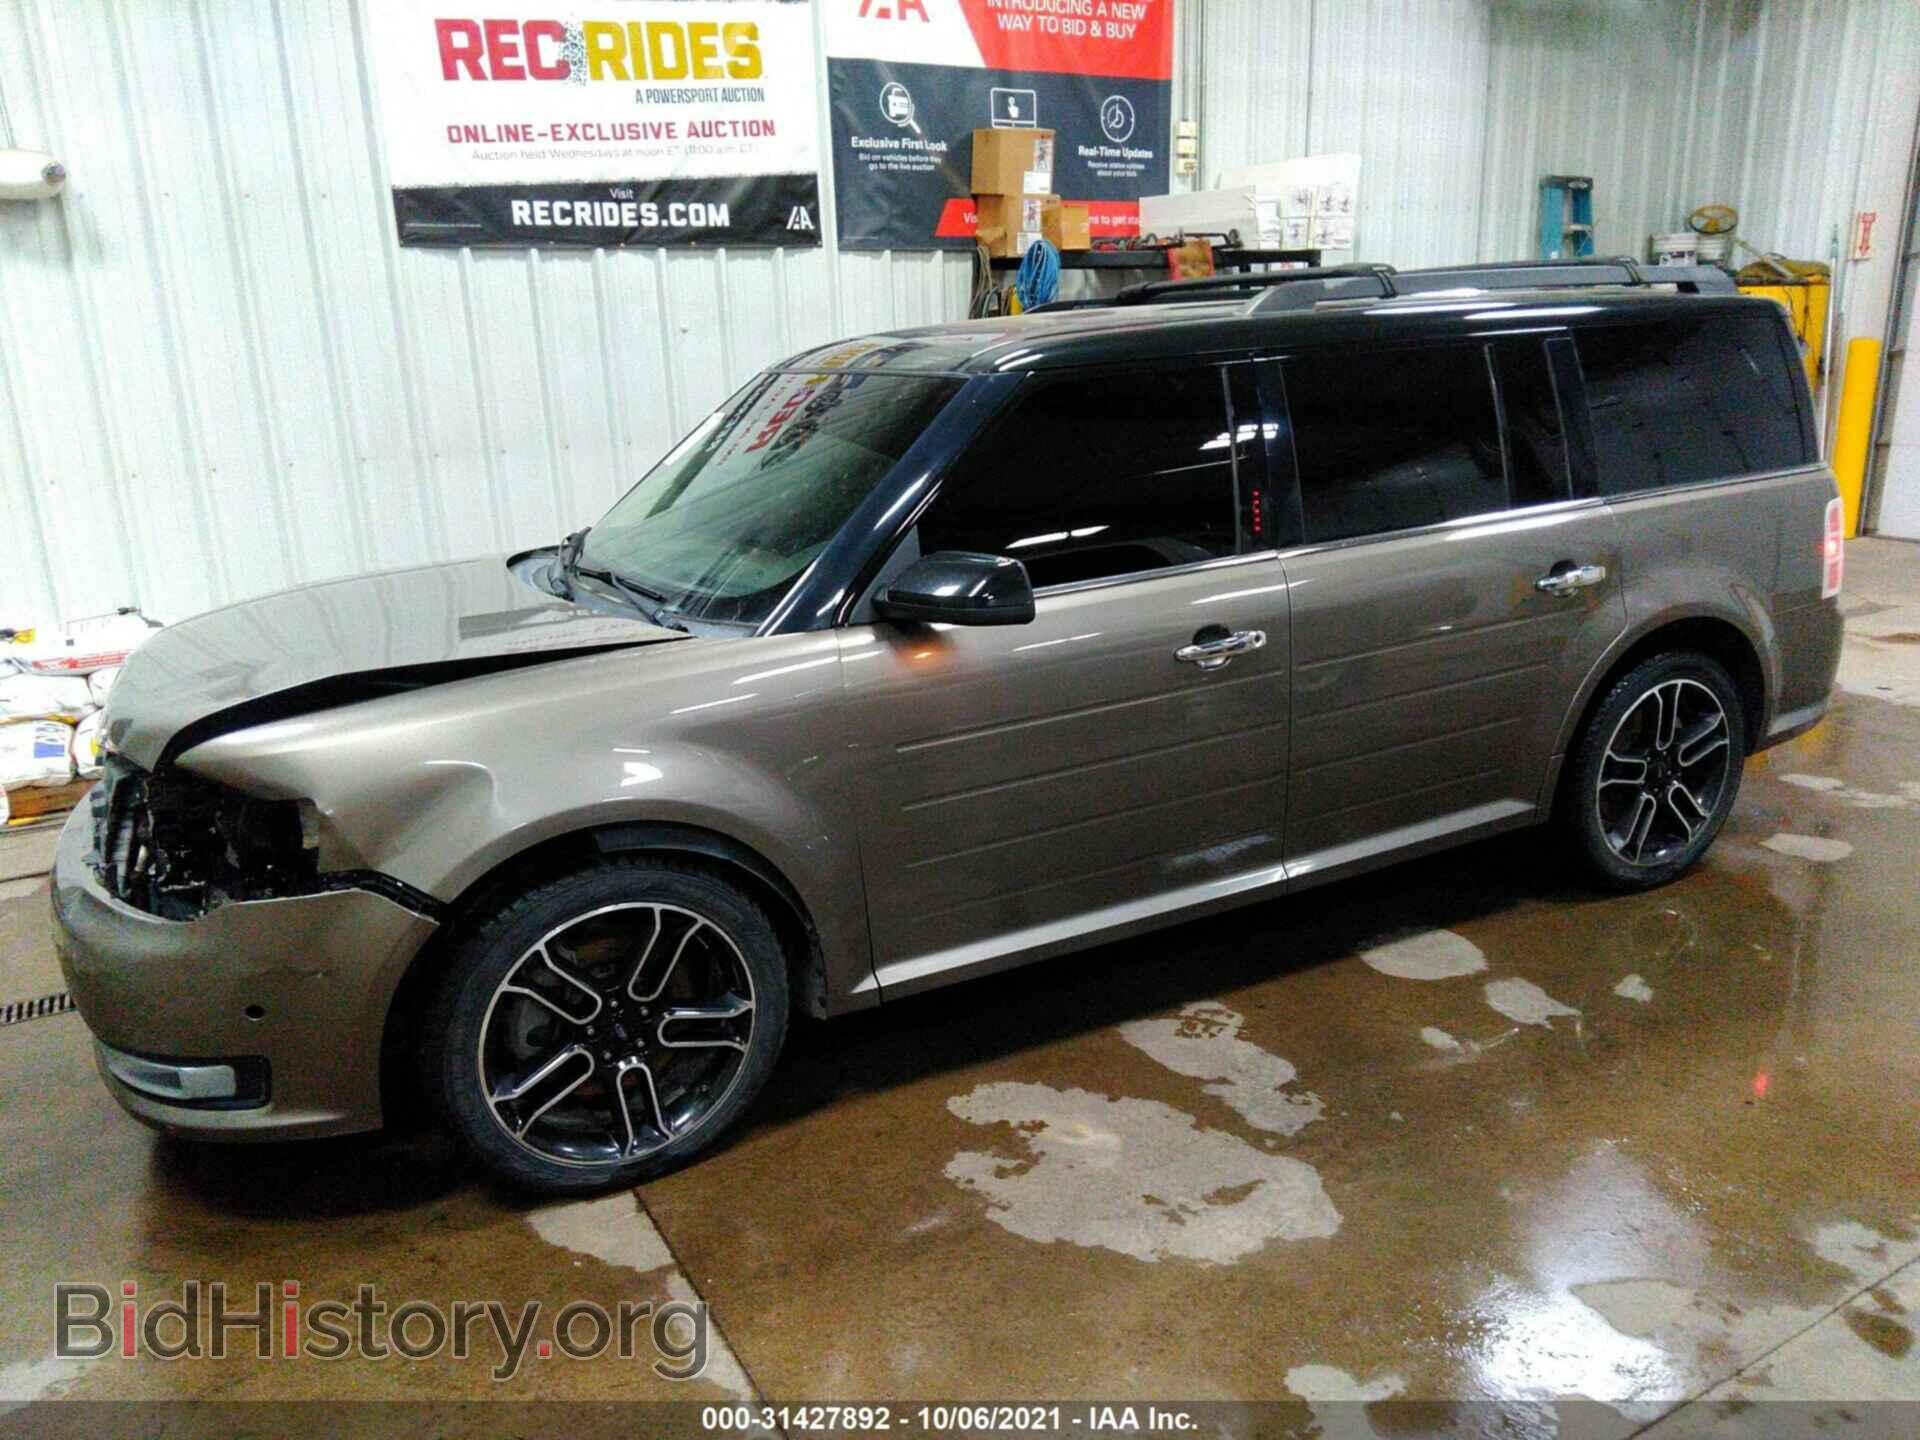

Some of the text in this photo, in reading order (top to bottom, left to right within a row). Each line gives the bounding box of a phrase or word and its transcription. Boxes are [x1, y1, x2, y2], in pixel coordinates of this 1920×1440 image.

[1097, 3, 1107, 17] A
[1111, 3, 1147, 20] NEW
[997, 13, 1136, 39] WAY TO BID & BUY
[635, 87, 765, 104] A POWERSPORT AUCTION
[447, 119, 776, 144] ONLINE-EXCLUSIVE AUCTION
[851, 136, 948, 151] Exclusive First Look
[1078, 145, 1153, 160] Real-Time Updates
[610, 188, 634, 199] Visit
[511, 200, 730, 227] RECRIDES.COM
